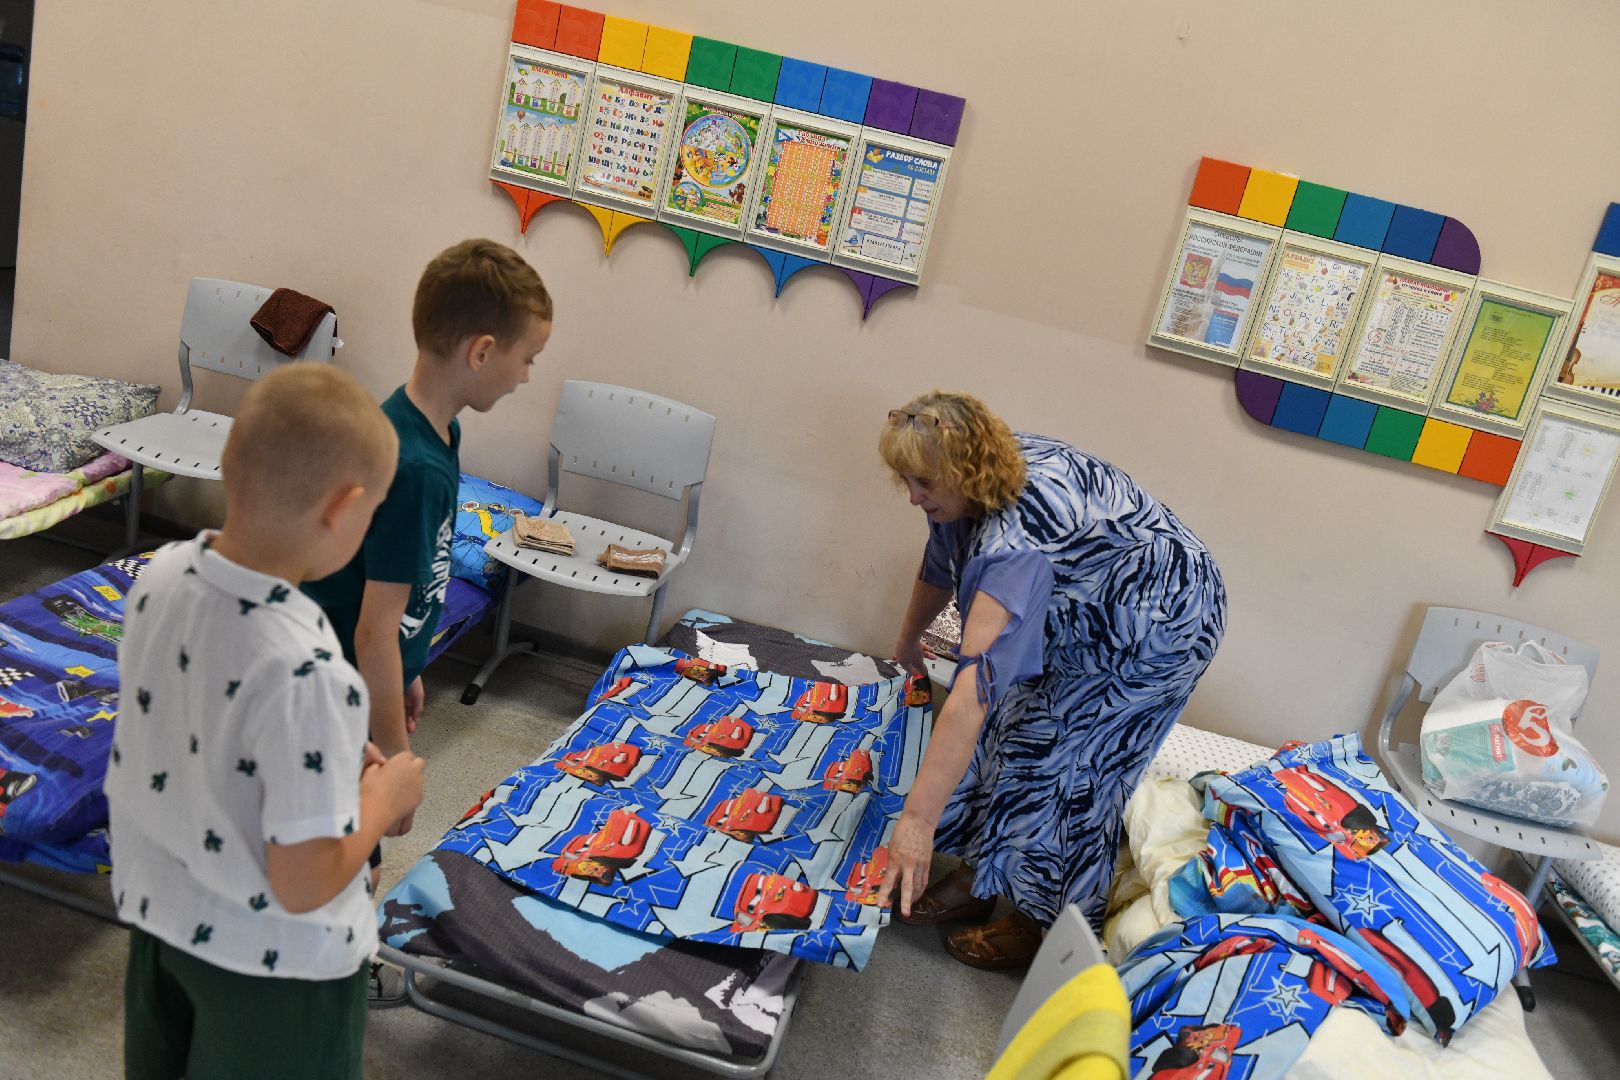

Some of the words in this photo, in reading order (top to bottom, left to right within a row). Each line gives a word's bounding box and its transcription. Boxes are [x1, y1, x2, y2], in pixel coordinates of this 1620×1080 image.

[618, 86, 653, 100] Алфавит
[885, 150, 913, 163] РАЗБОР
[914, 158, 938, 170] СЛОВА
[1518, 705, 1551, 747] 5
[1494, 733, 1503, 758] МАГНИТ
